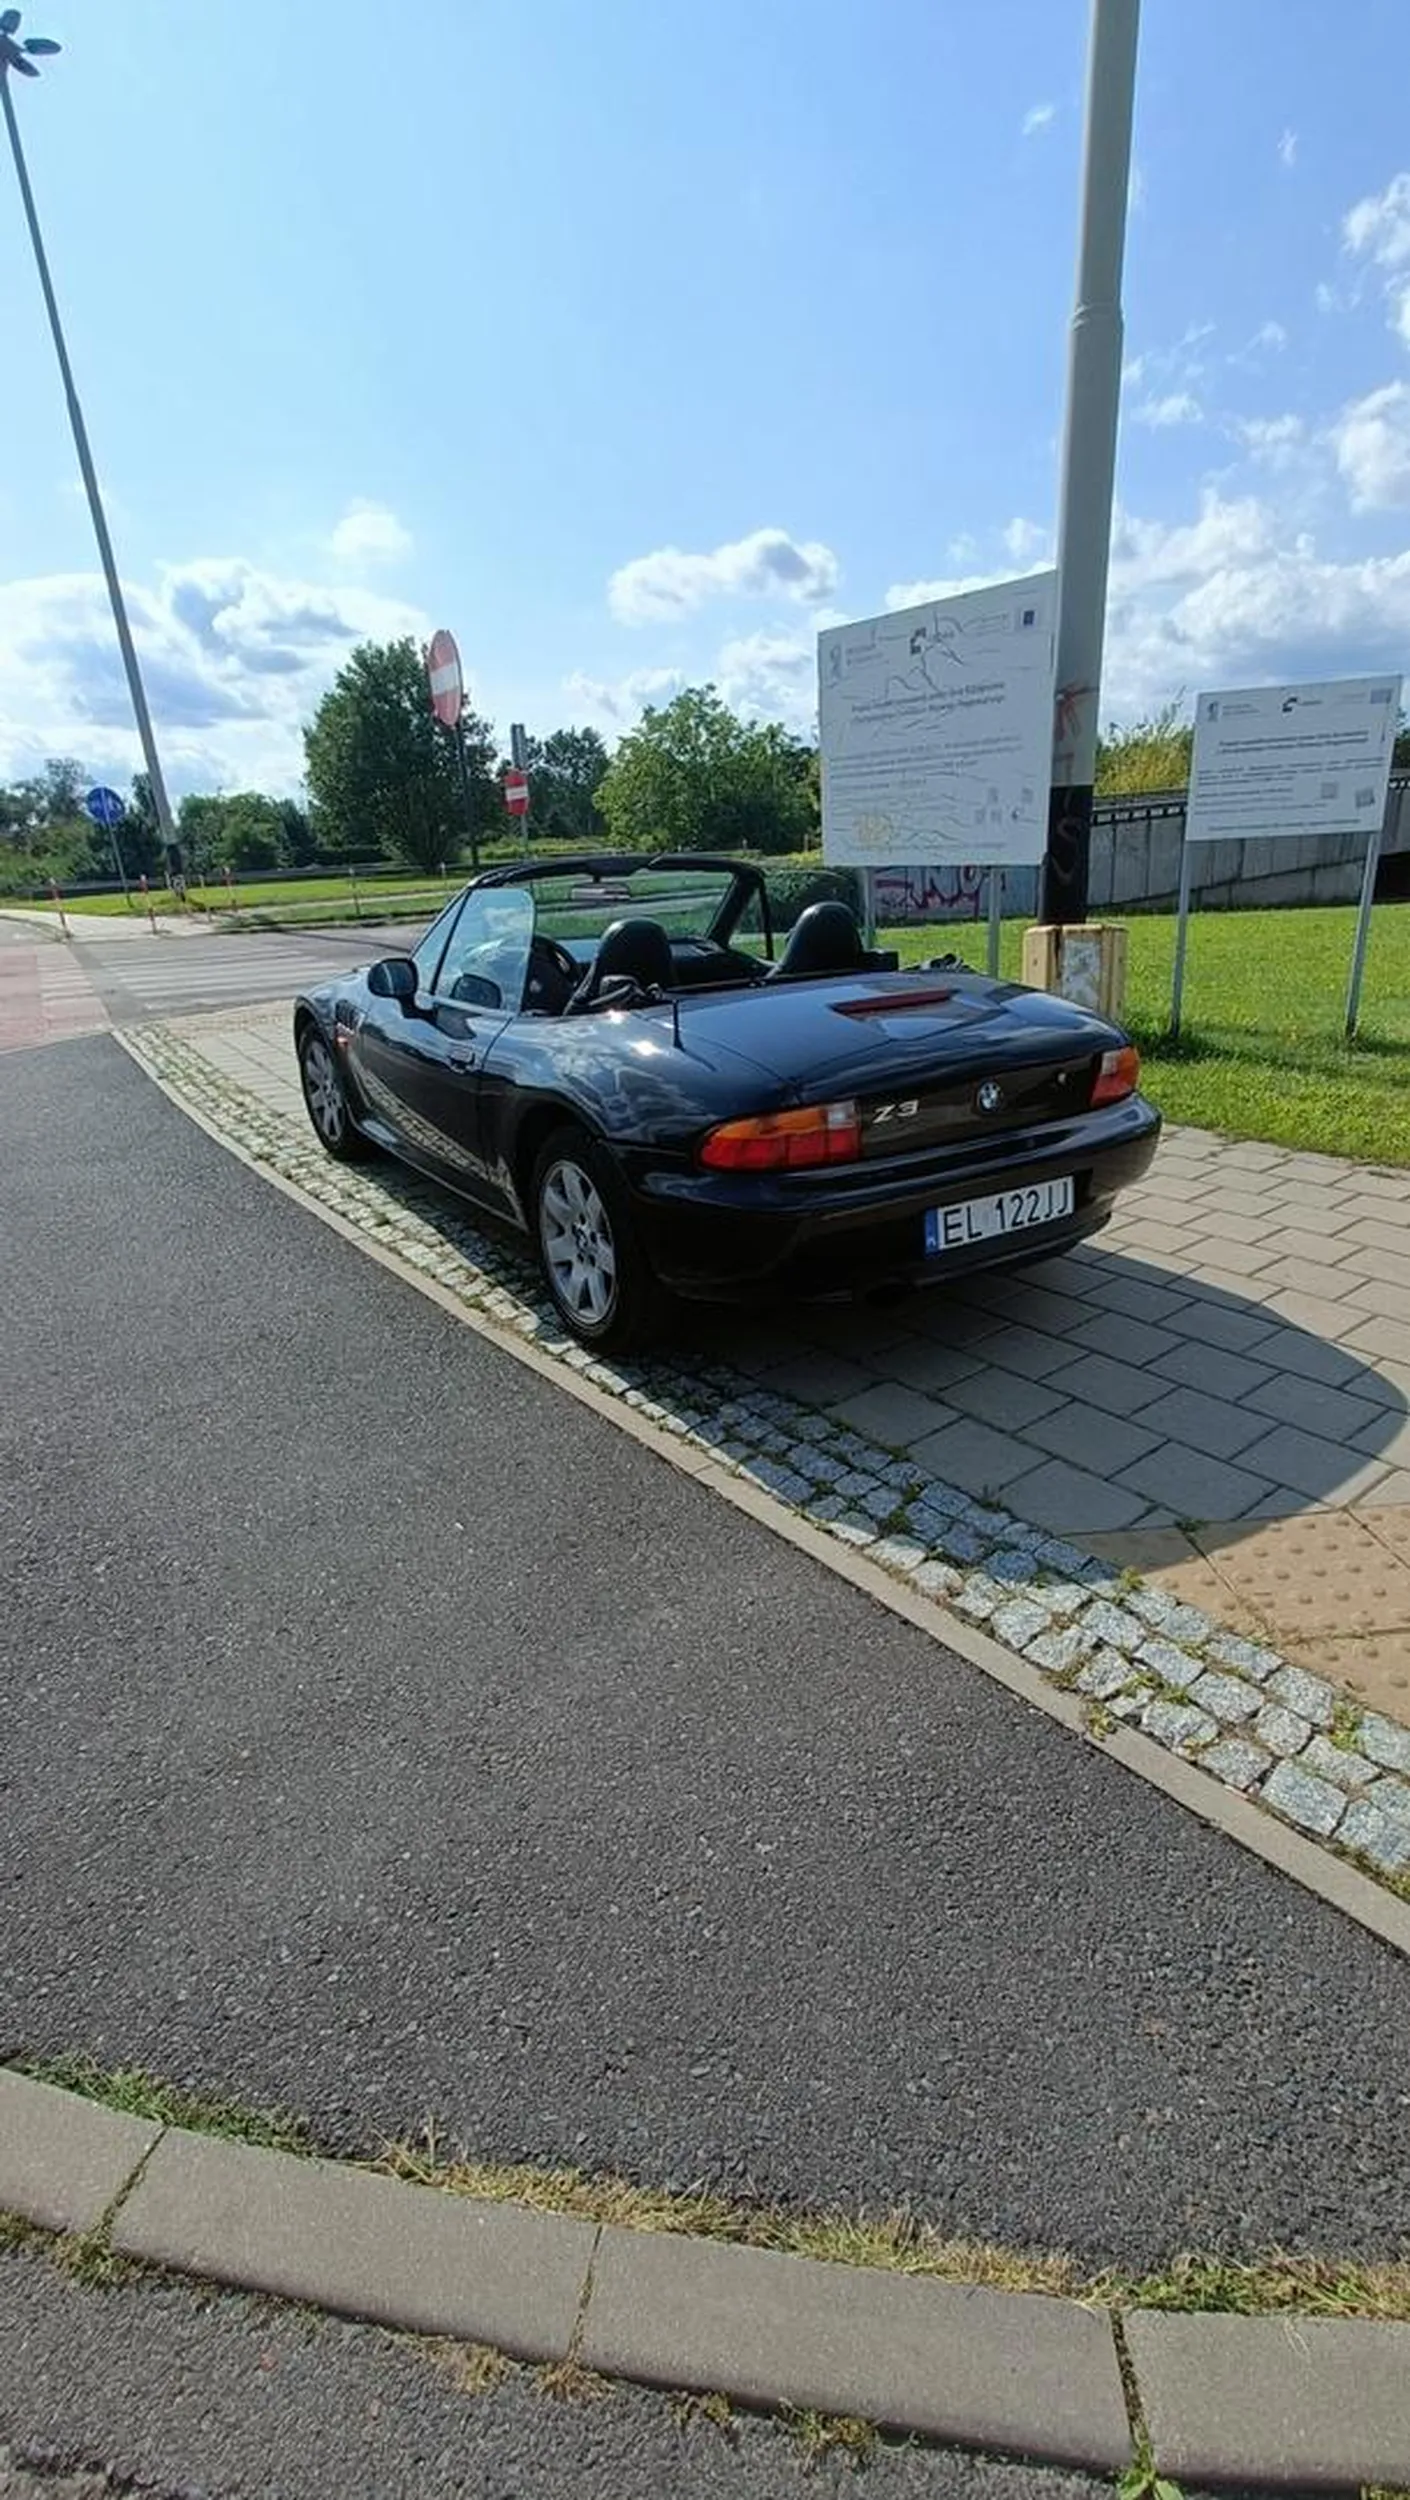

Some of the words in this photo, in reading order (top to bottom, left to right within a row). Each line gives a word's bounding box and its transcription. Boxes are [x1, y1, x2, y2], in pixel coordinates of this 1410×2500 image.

[873, 1099, 919, 1124] Z3
[943, 1205, 982, 1245] EL
[995, 1181, 1069, 1231] 122JJ
